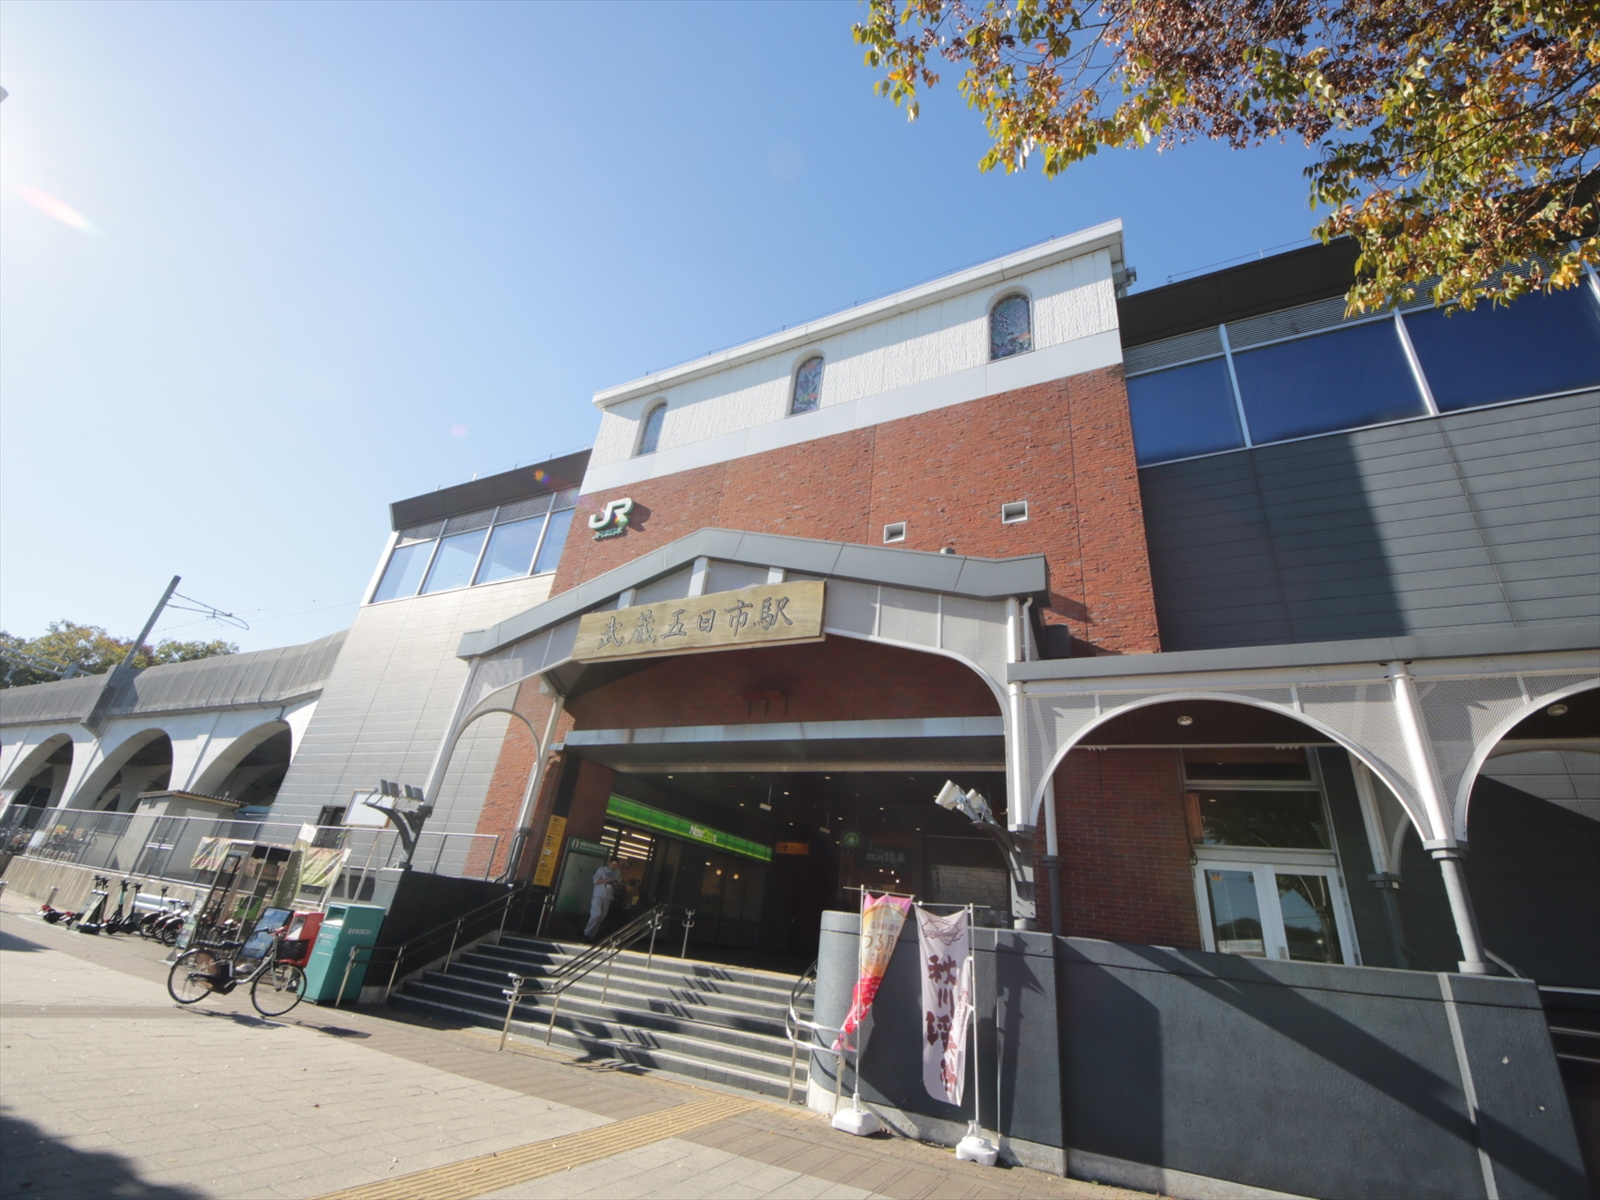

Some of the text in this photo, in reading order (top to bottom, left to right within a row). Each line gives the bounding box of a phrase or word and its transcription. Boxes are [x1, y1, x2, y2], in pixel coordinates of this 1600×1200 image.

[588, 497, 634, 531] JR
[596, 596, 793, 650] 武蔵五日市駅
